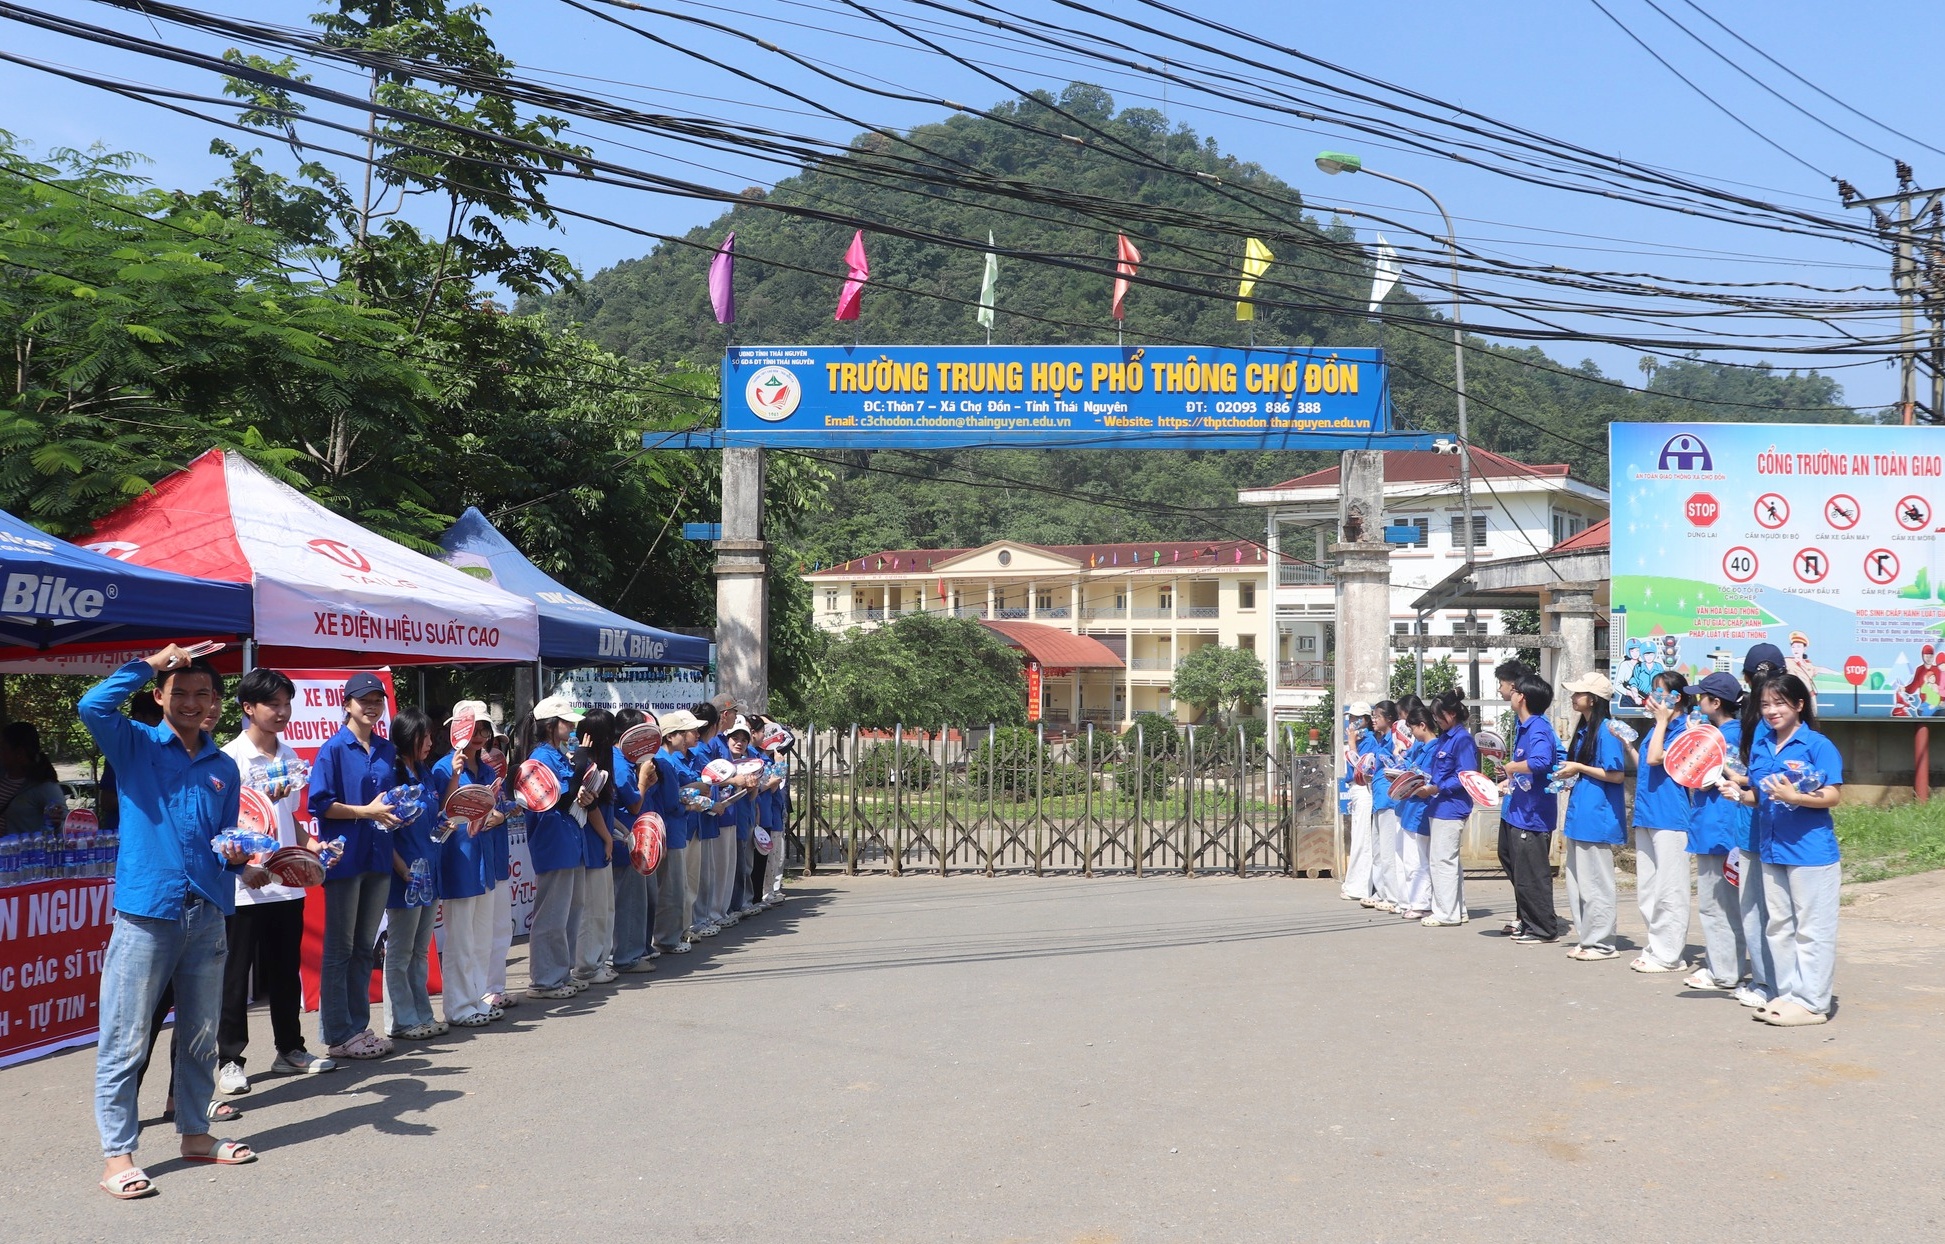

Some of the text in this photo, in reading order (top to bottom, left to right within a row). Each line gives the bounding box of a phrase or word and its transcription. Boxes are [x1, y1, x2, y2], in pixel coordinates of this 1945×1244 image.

[826, 348, 1358, 399] TRƯỜNG TRUNG HỌC PHỔ THÔNG CHỢ ĐỒN
[886, 401, 914, 412] Thôn
[916, 401, 924, 412] 7
[940, 401, 956, 412] Xã
[960, 401, 982, 414] Chợ
[987, 400, 1011, 412] Đồn
[1025, 400, 1050, 412] Tỉnh
[1054, 401, 1078, 412] Thái
[1083, 401, 1128, 415] Nguyên
[1215, 402, 1257, 413] 02093
[1265, 402, 1290, 413] 886
[1297, 402, 1321, 413] 388
[824, 415, 859, 427] Email:
[860, 415, 1071, 429] c3chodon.chodon@thainguyen.edu.vn
[1103, 415, 1153, 427] Website:
[1757, 445, 1942, 477] CỔNG TRƯỜNG AN TOÀN GIAO
[1688, 502, 1716, 517] STOP
[1731, 557, 1750, 572] 40
[342, 574, 418, 590] TAILG
[313, 610, 500, 647] XE ĐIỆN HIỆU SUẤT CAO
[598, 627, 629, 657] DK
[1846, 665, 1867, 675] STOP
[303, 687, 321, 707] XE
[594, 701, 617, 710] TRUNG
[651, 700, 675, 710] THÔNG
[283, 717, 339, 741] NGUYÊN
[21, 955, 58, 988] CÁC
[64, 948, 83, 981] SĨ
[28, 998, 53, 1034] TỰ
[56, 994, 86, 1024] TIN
